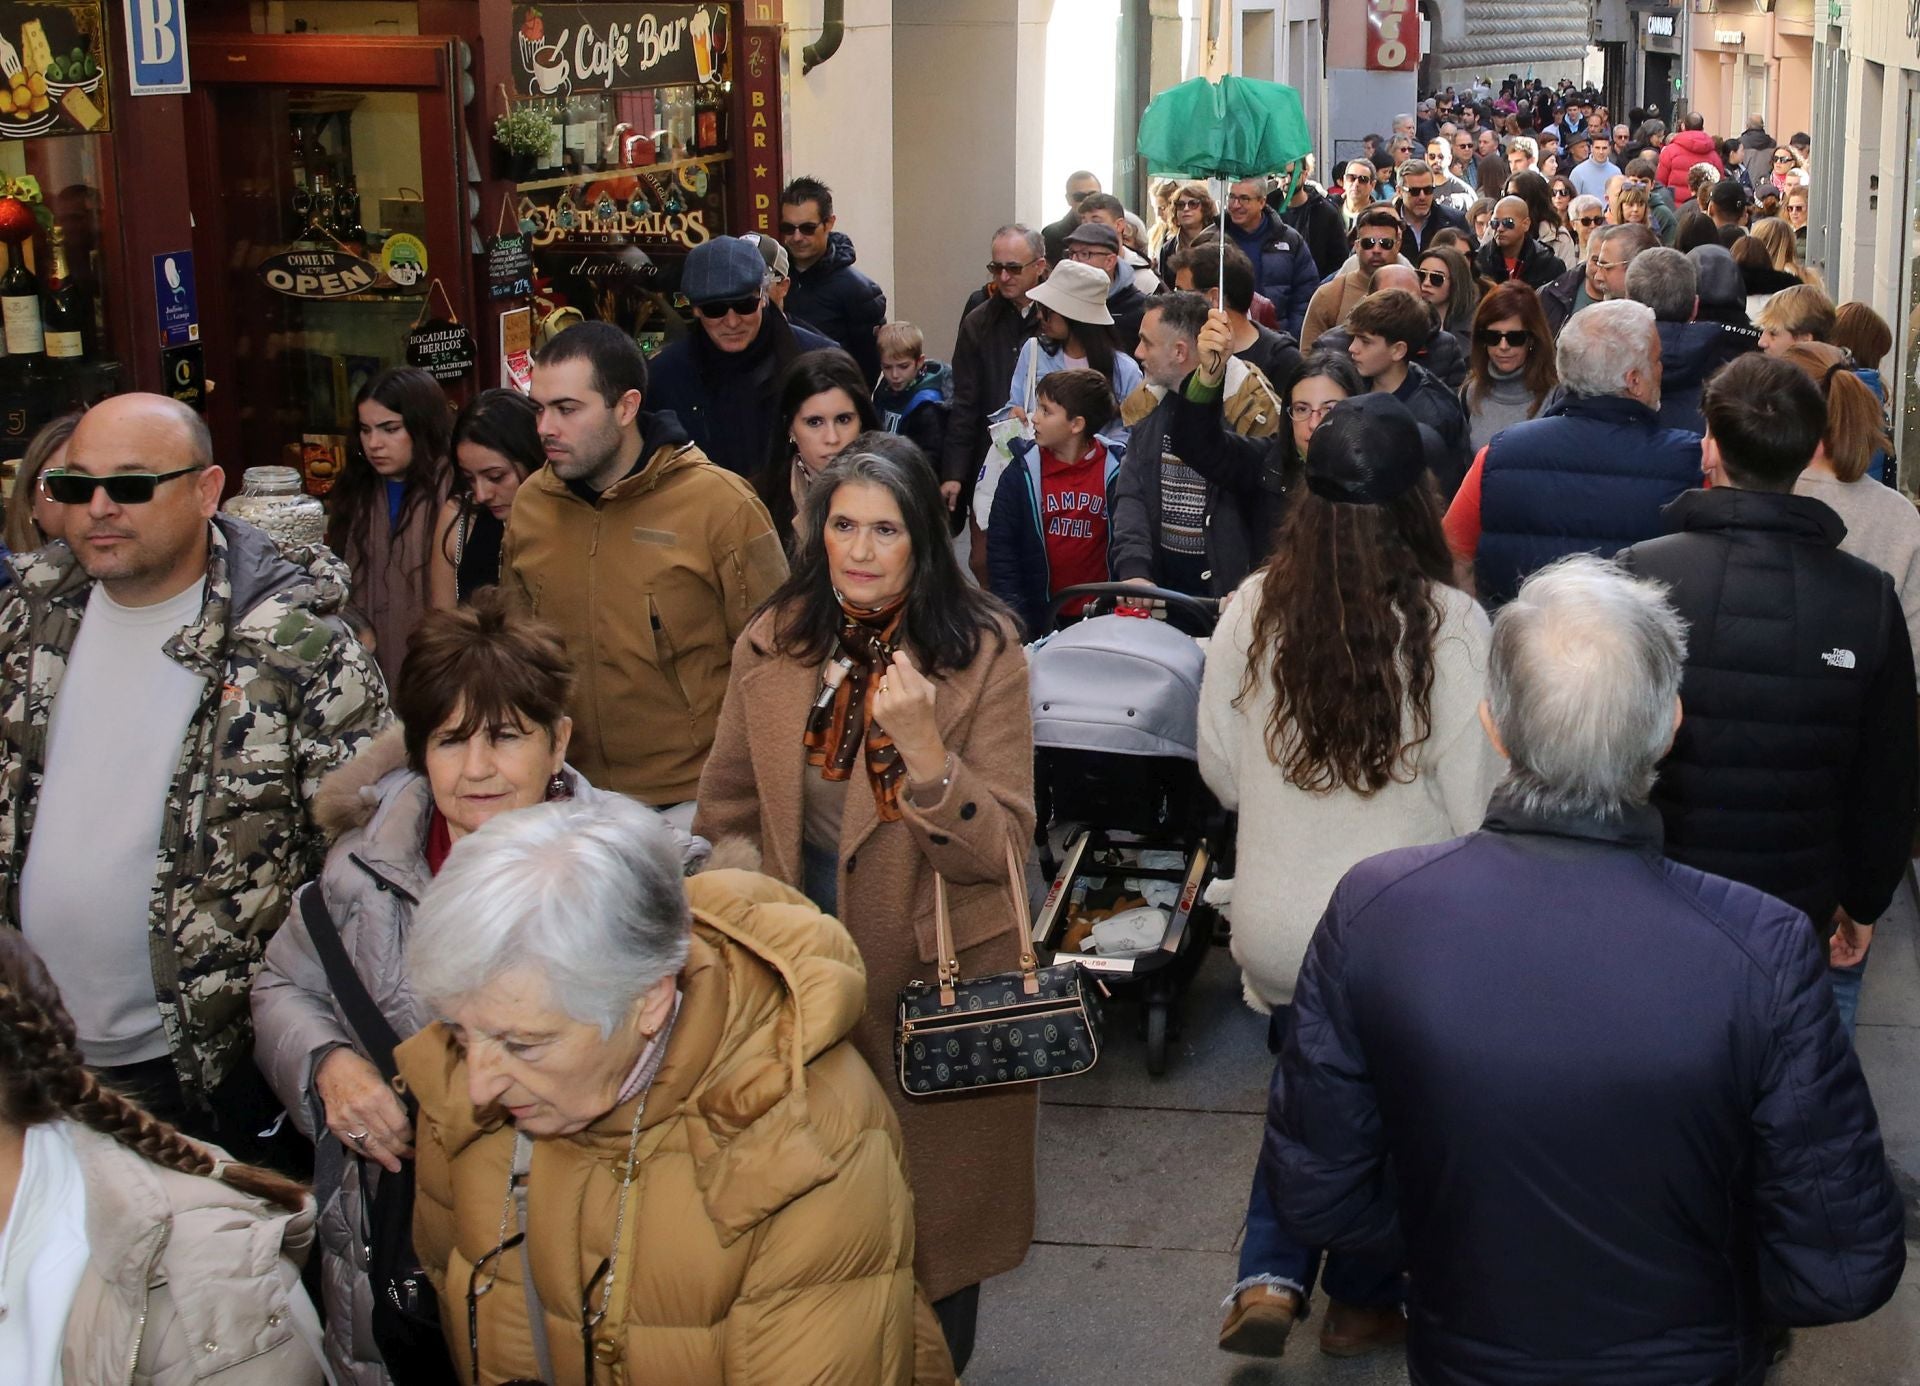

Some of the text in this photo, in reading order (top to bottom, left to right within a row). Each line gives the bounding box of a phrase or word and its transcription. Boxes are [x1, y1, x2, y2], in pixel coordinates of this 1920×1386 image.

[575, 13, 688, 89] Café Bar
[752, 91, 767, 148] BAR
[287, 254, 336, 266] COME IN
[266, 265, 372, 296] OPEN
[410, 328, 466, 345] BOCADILLOS
[419, 339, 462, 354] IBERICOS
[1041, 491, 1108, 520] AMPU
[1049, 516, 1093, 538] ATHL
